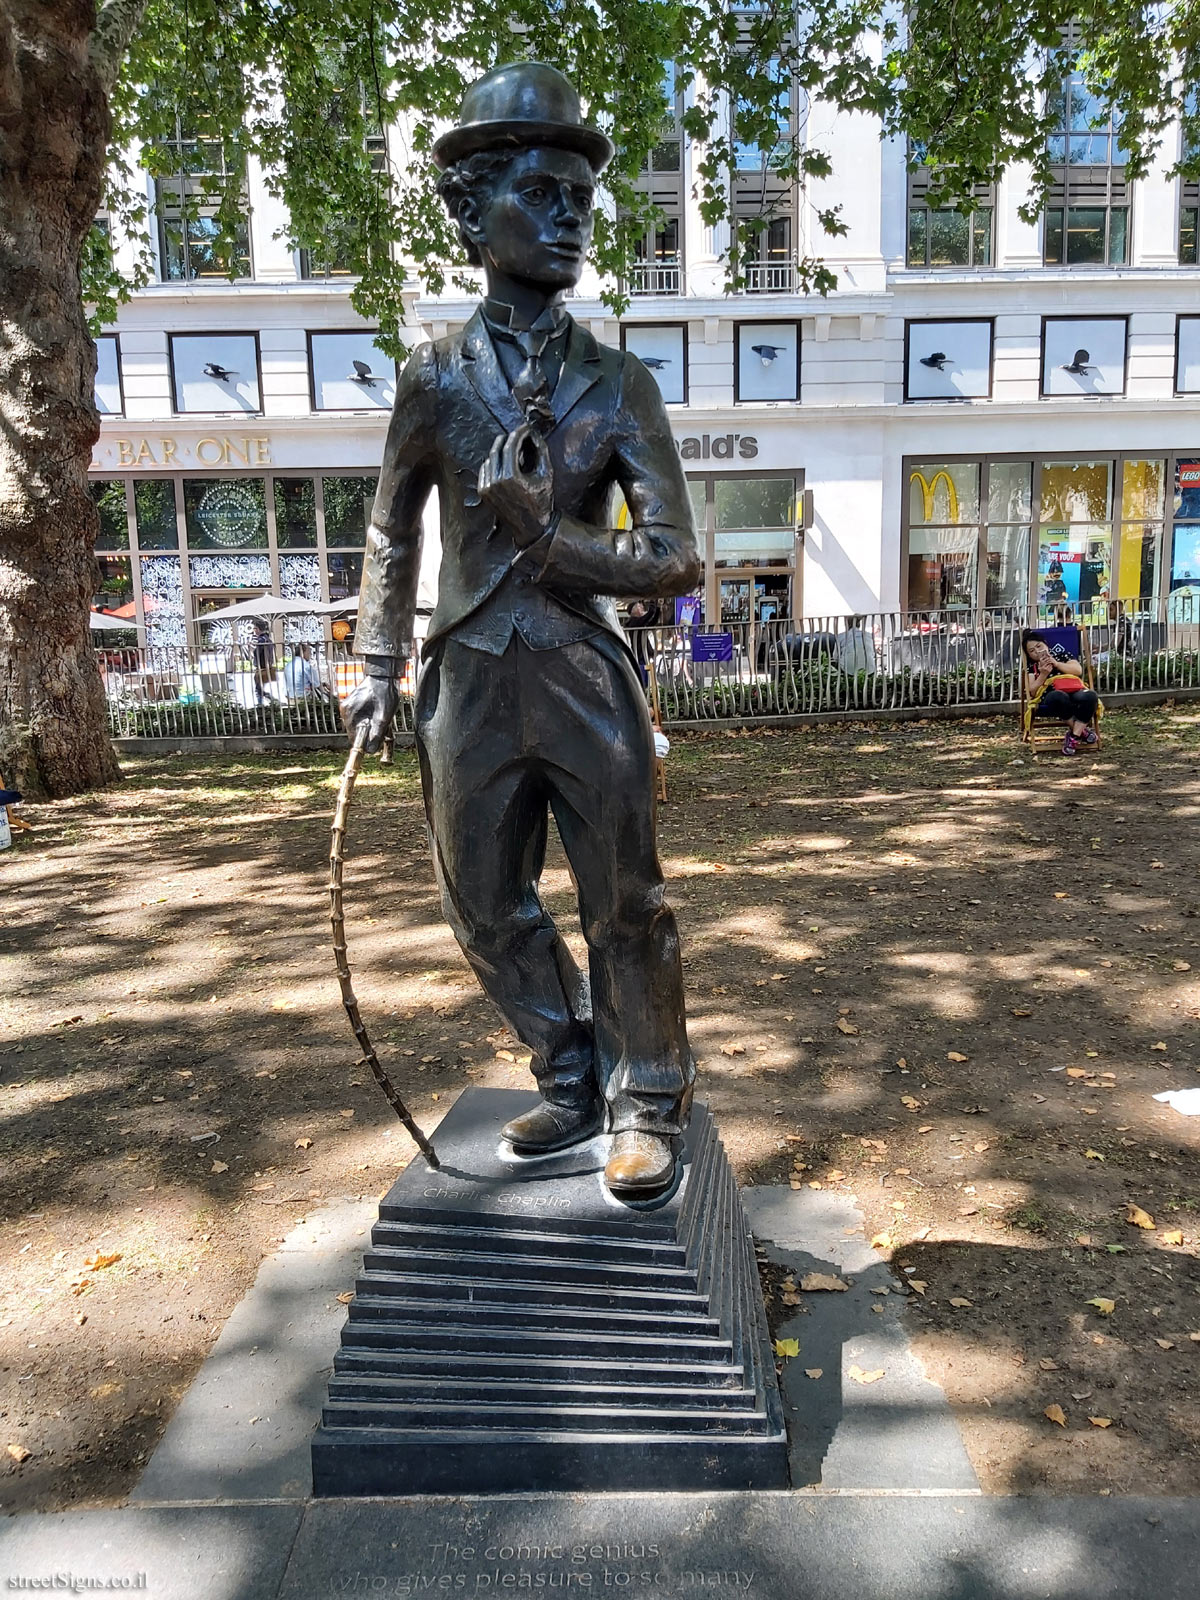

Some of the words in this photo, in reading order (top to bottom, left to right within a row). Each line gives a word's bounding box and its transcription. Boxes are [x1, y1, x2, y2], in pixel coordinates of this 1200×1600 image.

[116, 439, 181, 467] BAR
[196, 437, 272, 466] ONE
[675, 434, 759, 459] ald's
[1181, 471, 1200, 481] LEGO
[422, 1187, 491, 1202] Charlie
[498, 1193, 572, 1209] Chaplin
[428, 1543, 475, 1562] The
[483, 1541, 563, 1561] comic
[571, 1541, 660, 1564] genius
[328, 1570, 388, 1592] who
[396, 1570, 466, 1595] gives
[476, 1568, 593, 1594] pleasure
[604, 1569, 630, 1587] to
[676, 1568, 756, 1591] many
